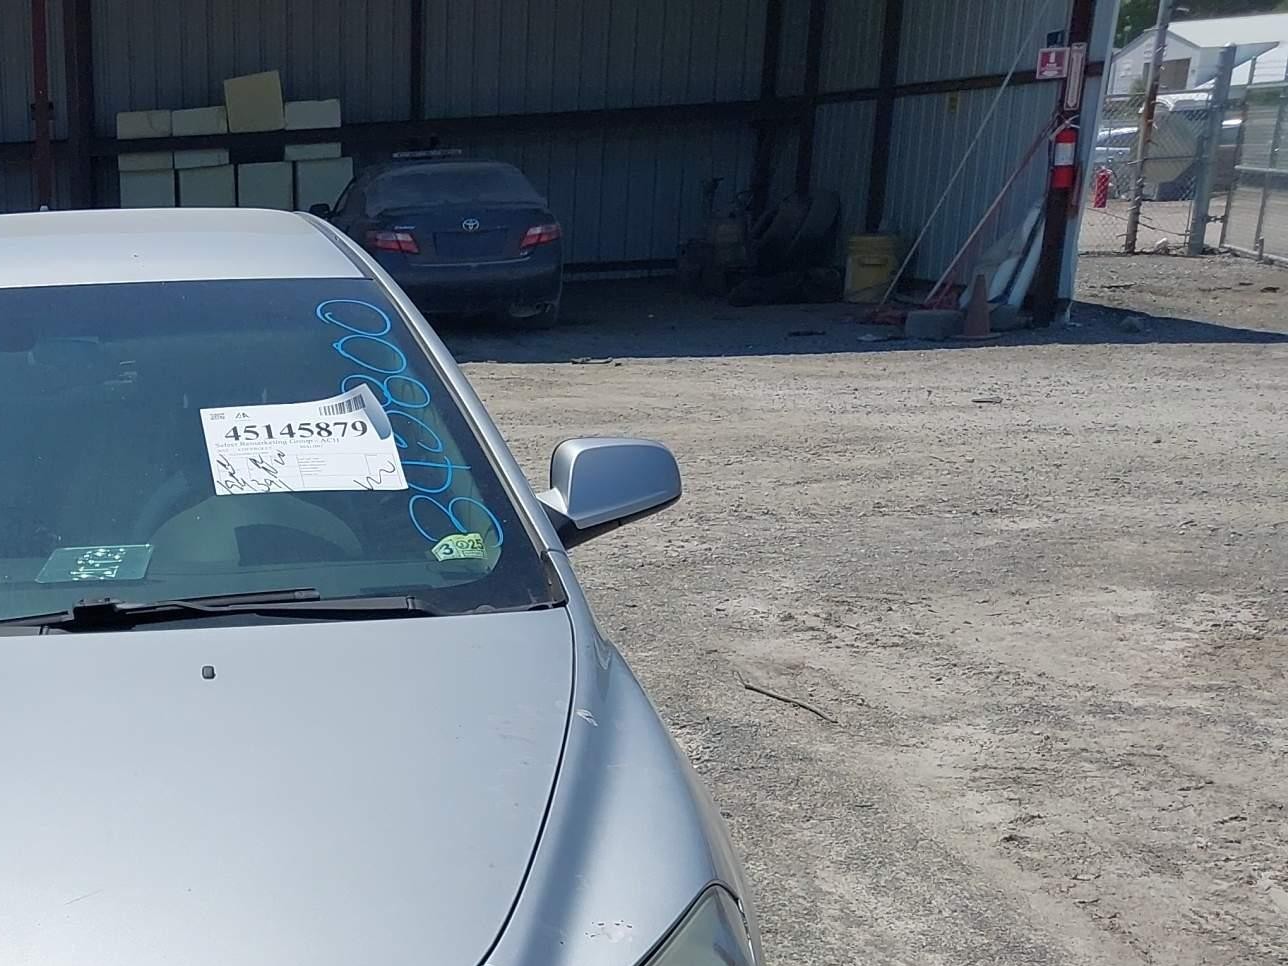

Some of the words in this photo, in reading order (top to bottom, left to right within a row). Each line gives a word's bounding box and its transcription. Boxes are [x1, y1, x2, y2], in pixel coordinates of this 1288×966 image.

[224, 420, 368, 441] 45145879
[440, 543, 454, 555] 3
[468, 538, 484, 550] 25
